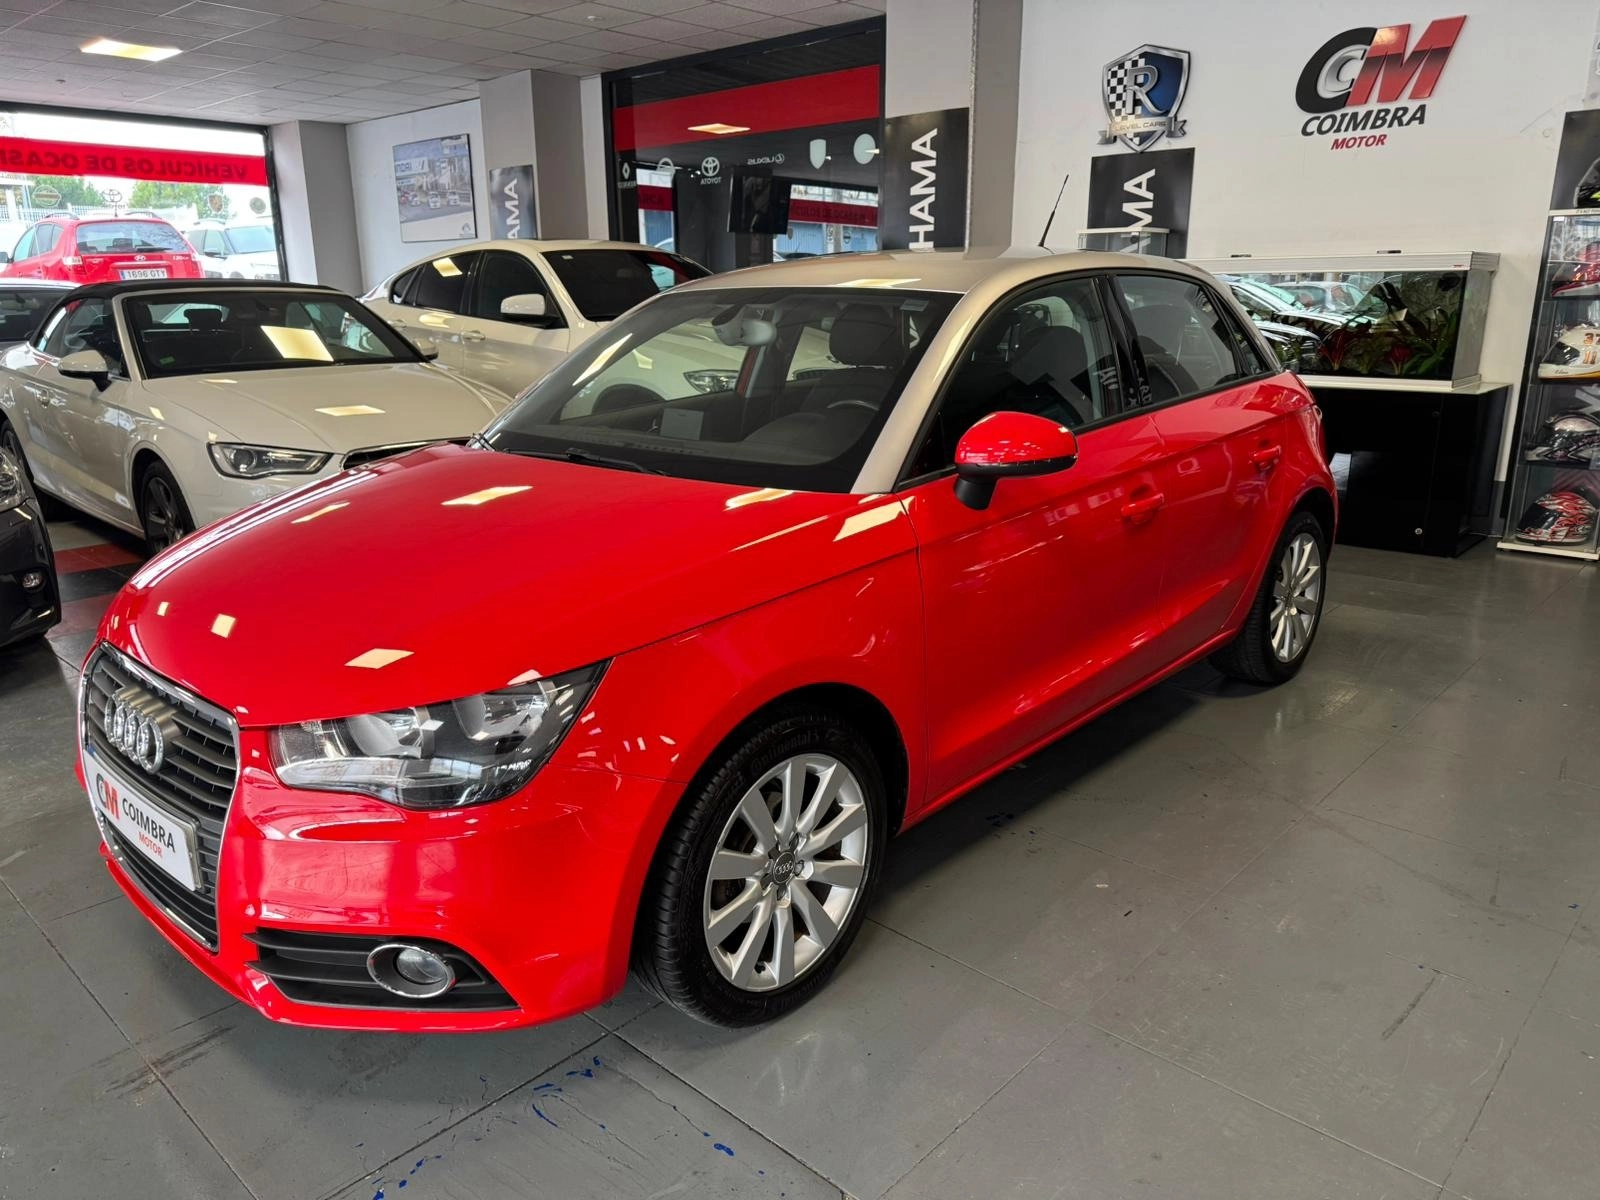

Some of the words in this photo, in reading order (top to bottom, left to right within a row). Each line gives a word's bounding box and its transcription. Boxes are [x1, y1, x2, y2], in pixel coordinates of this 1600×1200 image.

[1301, 104, 1427, 137] COIMBRA
[1331, 134, 1387, 150] MOTOR
[122, 798, 176, 853] COIMBRA
[138, 831, 163, 857] MOTOR
